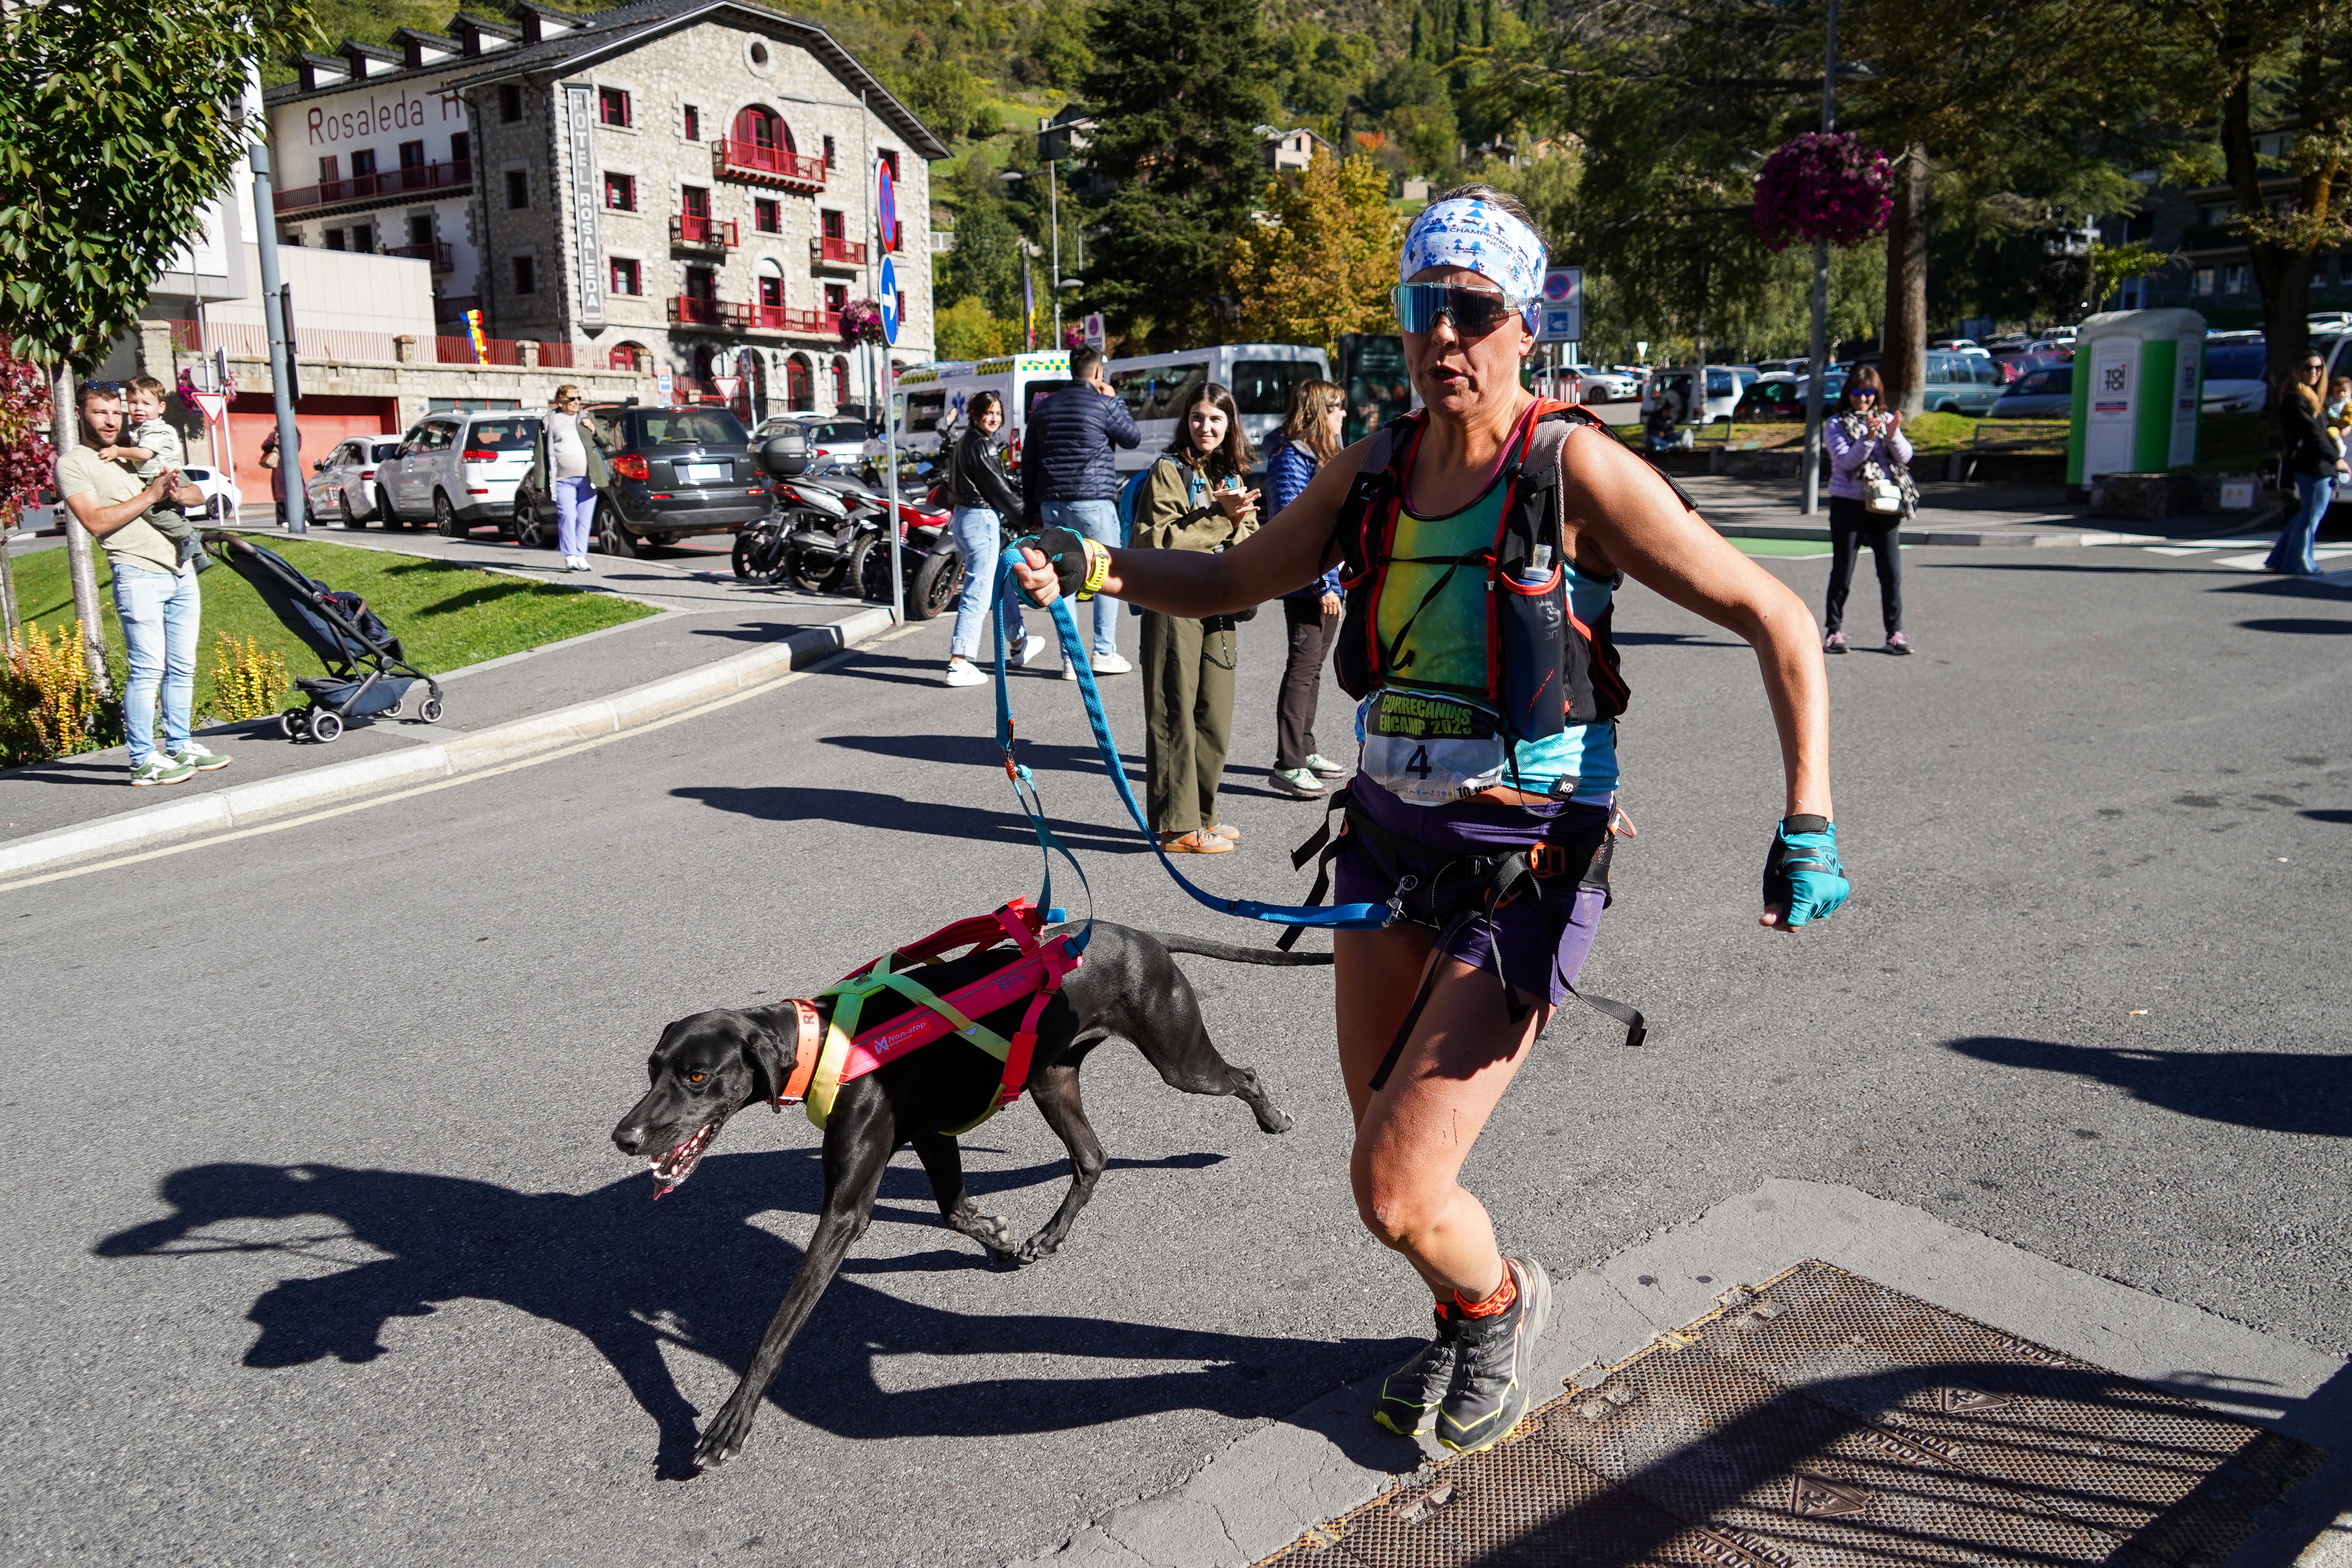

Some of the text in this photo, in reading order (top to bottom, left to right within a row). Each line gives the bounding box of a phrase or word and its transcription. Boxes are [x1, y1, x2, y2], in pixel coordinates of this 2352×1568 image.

[307, 89, 424, 145] Rosaleda
[572, 93, 599, 308] HOTEL ROSALEDA
[1449, 227, 1517, 254] CHAMPIONNAT
[1517, 254, 1526, 267] DE
[1486, 239, 1511, 257] NEIGE
[1381, 694, 1472, 726] CORRECANINS
[1379, 714, 1426, 736] ENCAMP
[1405, 744, 1432, 780] 4
[1456, 786, 1471, 798] 10
[998, 973, 1026, 992] RITA
[888, 1022, 926, 1044] Non-stop
[889, 1033, 913, 1048] dogwear
